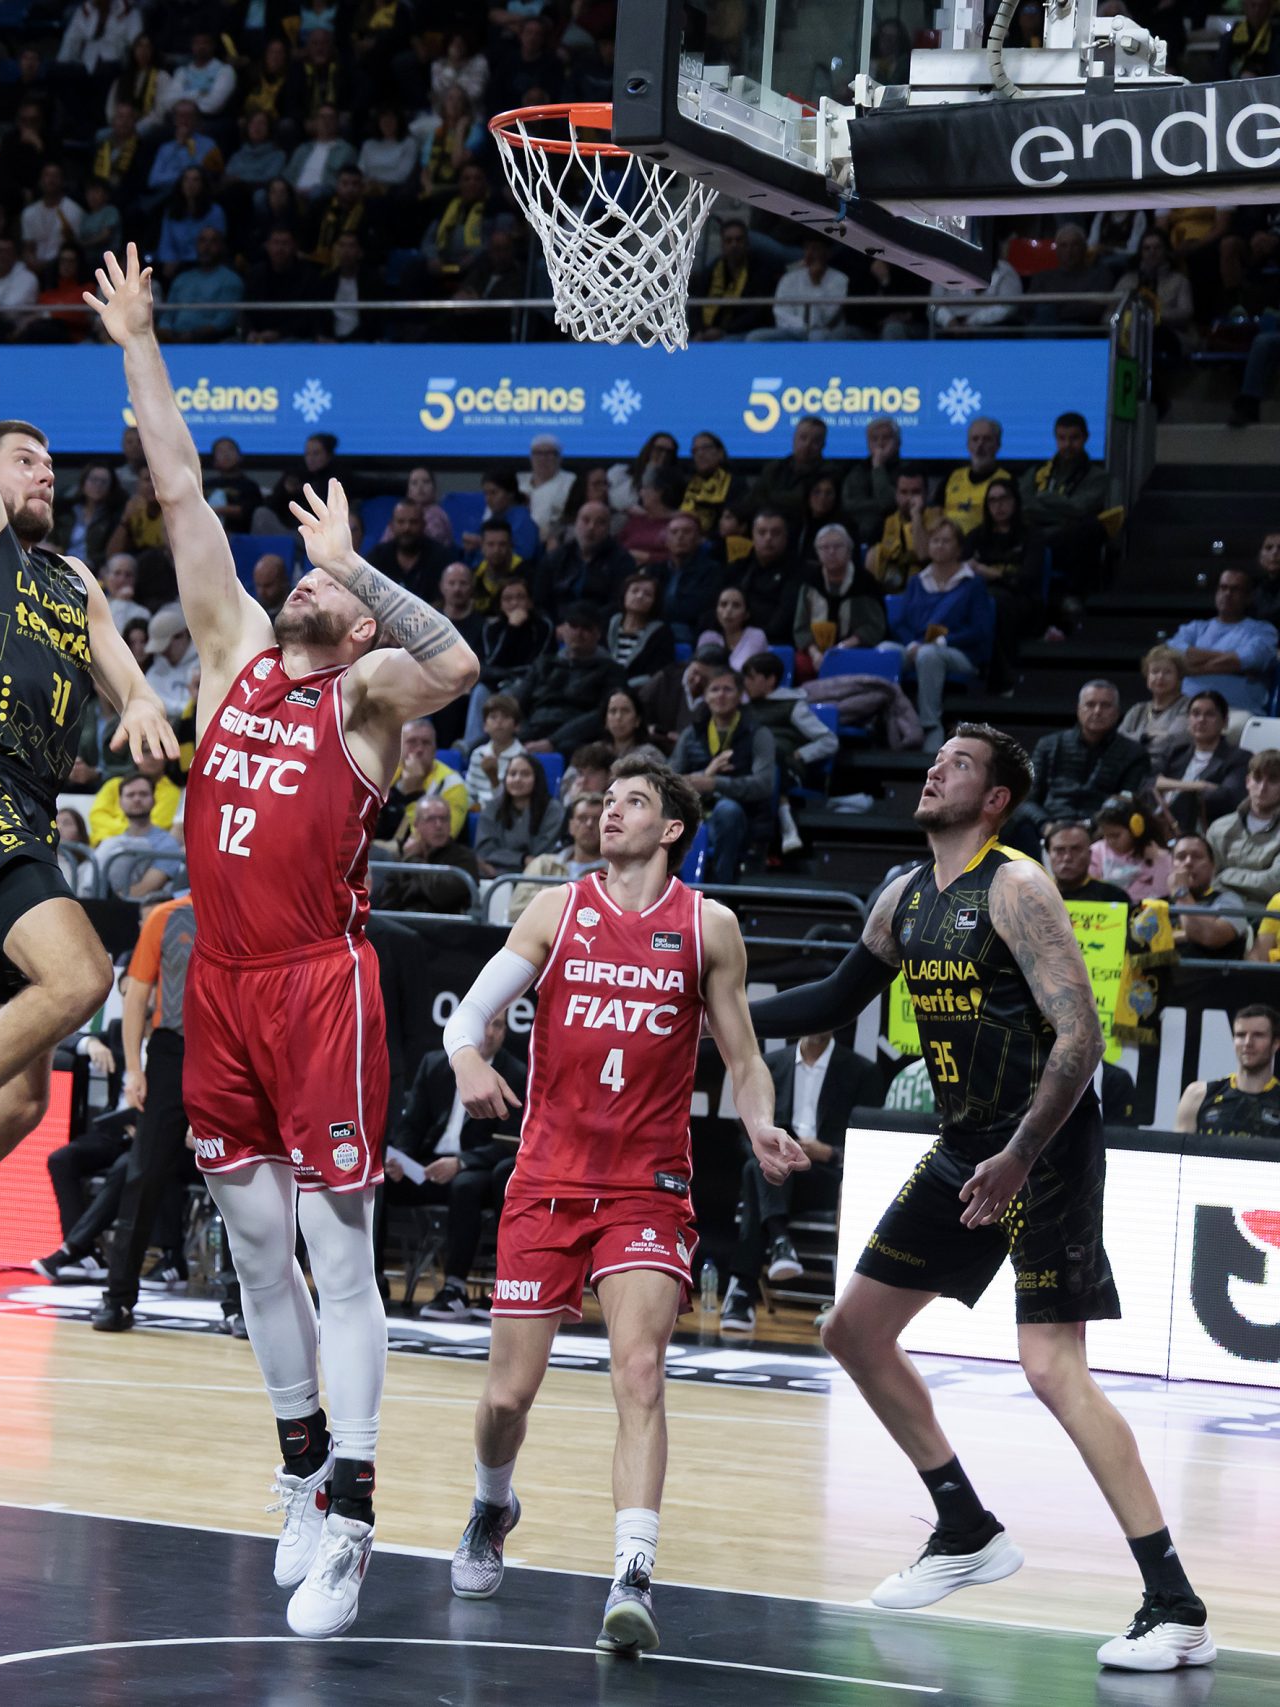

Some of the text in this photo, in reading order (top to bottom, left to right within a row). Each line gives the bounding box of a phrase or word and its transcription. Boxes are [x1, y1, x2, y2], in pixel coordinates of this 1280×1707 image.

[16, 571, 40, 602] LA
[218, 803, 257, 857] 12
[564, 959, 685, 993] GIRONA
[909, 960, 980, 981] LAGUNA
[564, 995, 678, 1036] FIATC
[599, 1048, 624, 1092] 4
[930, 1041, 959, 1083] 35
[333, 1129, 350, 1138] acb
[875, 1241, 927, 1267] Hospiten
